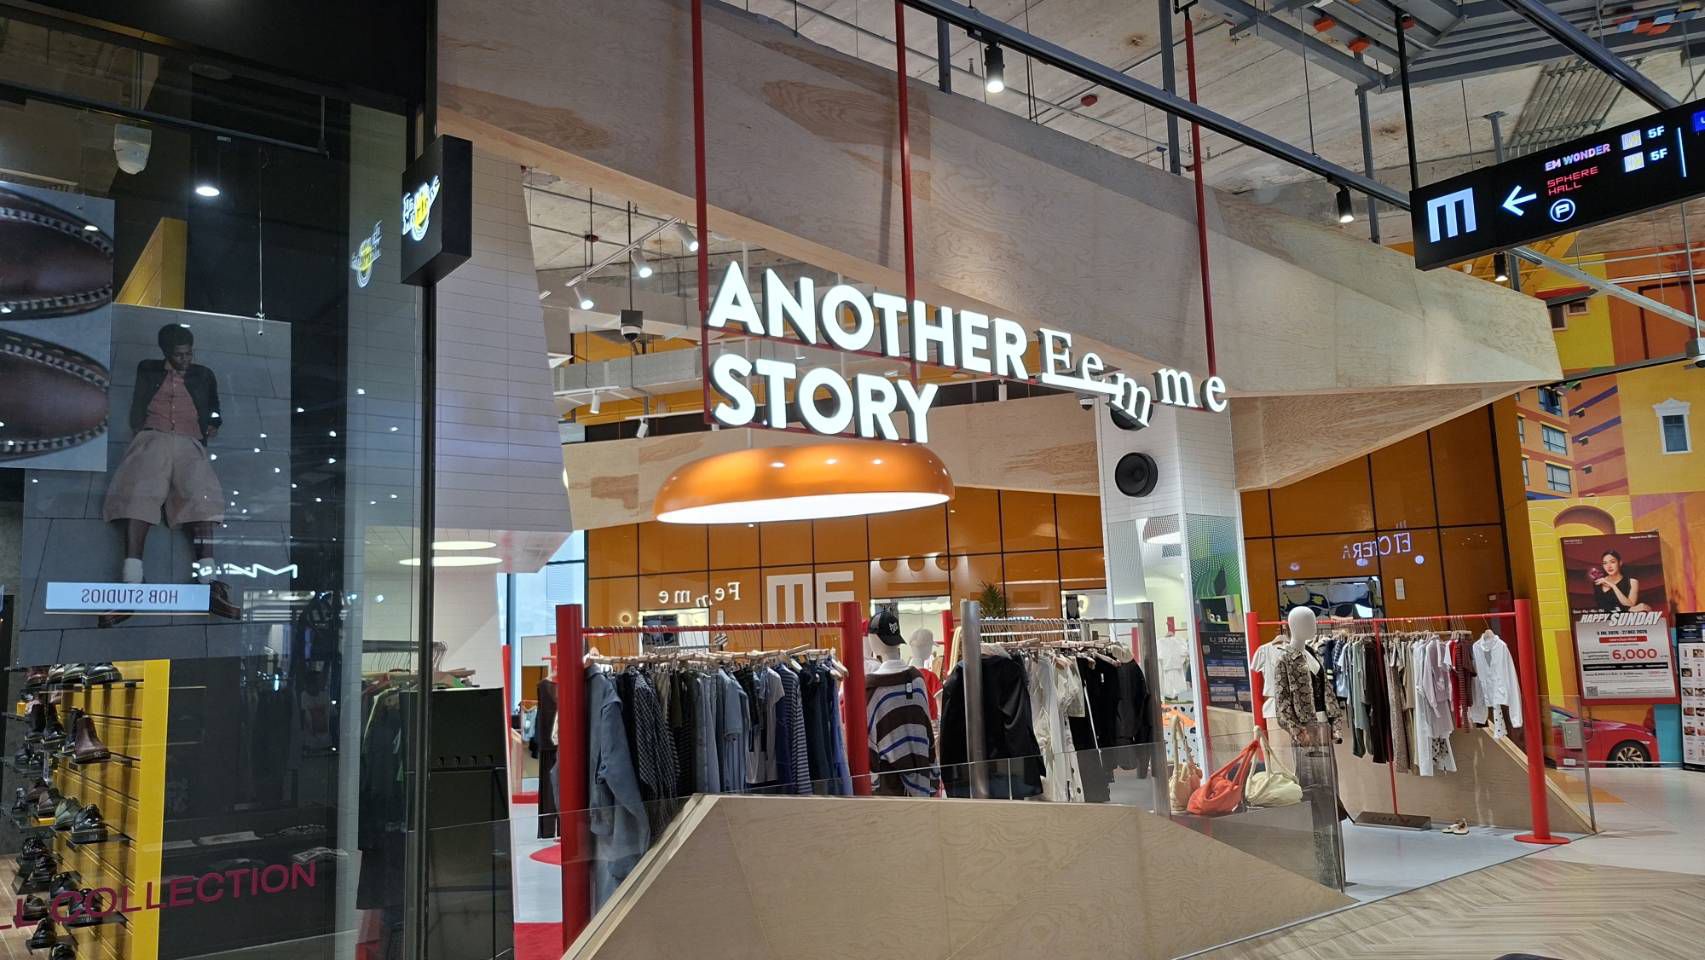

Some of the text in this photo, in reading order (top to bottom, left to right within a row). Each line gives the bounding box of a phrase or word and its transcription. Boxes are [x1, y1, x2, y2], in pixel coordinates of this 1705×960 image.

[1647, 125, 1665, 139] 5F
[1545, 143, 1611, 172] EM WONDER
[1650, 148, 1668, 161] 5F
[1547, 166, 1599, 188] SPHERE
[1548, 181, 1583, 196] HALL
[707, 260, 1029, 380] ANOTHER
[710, 354, 939, 444] STORY
[1580, 611, 1662, 626] HAPPY SUNDAY
[1612, 648, 1657, 660] 6,000
[0, 860, 316, 930] L COLLECTION
